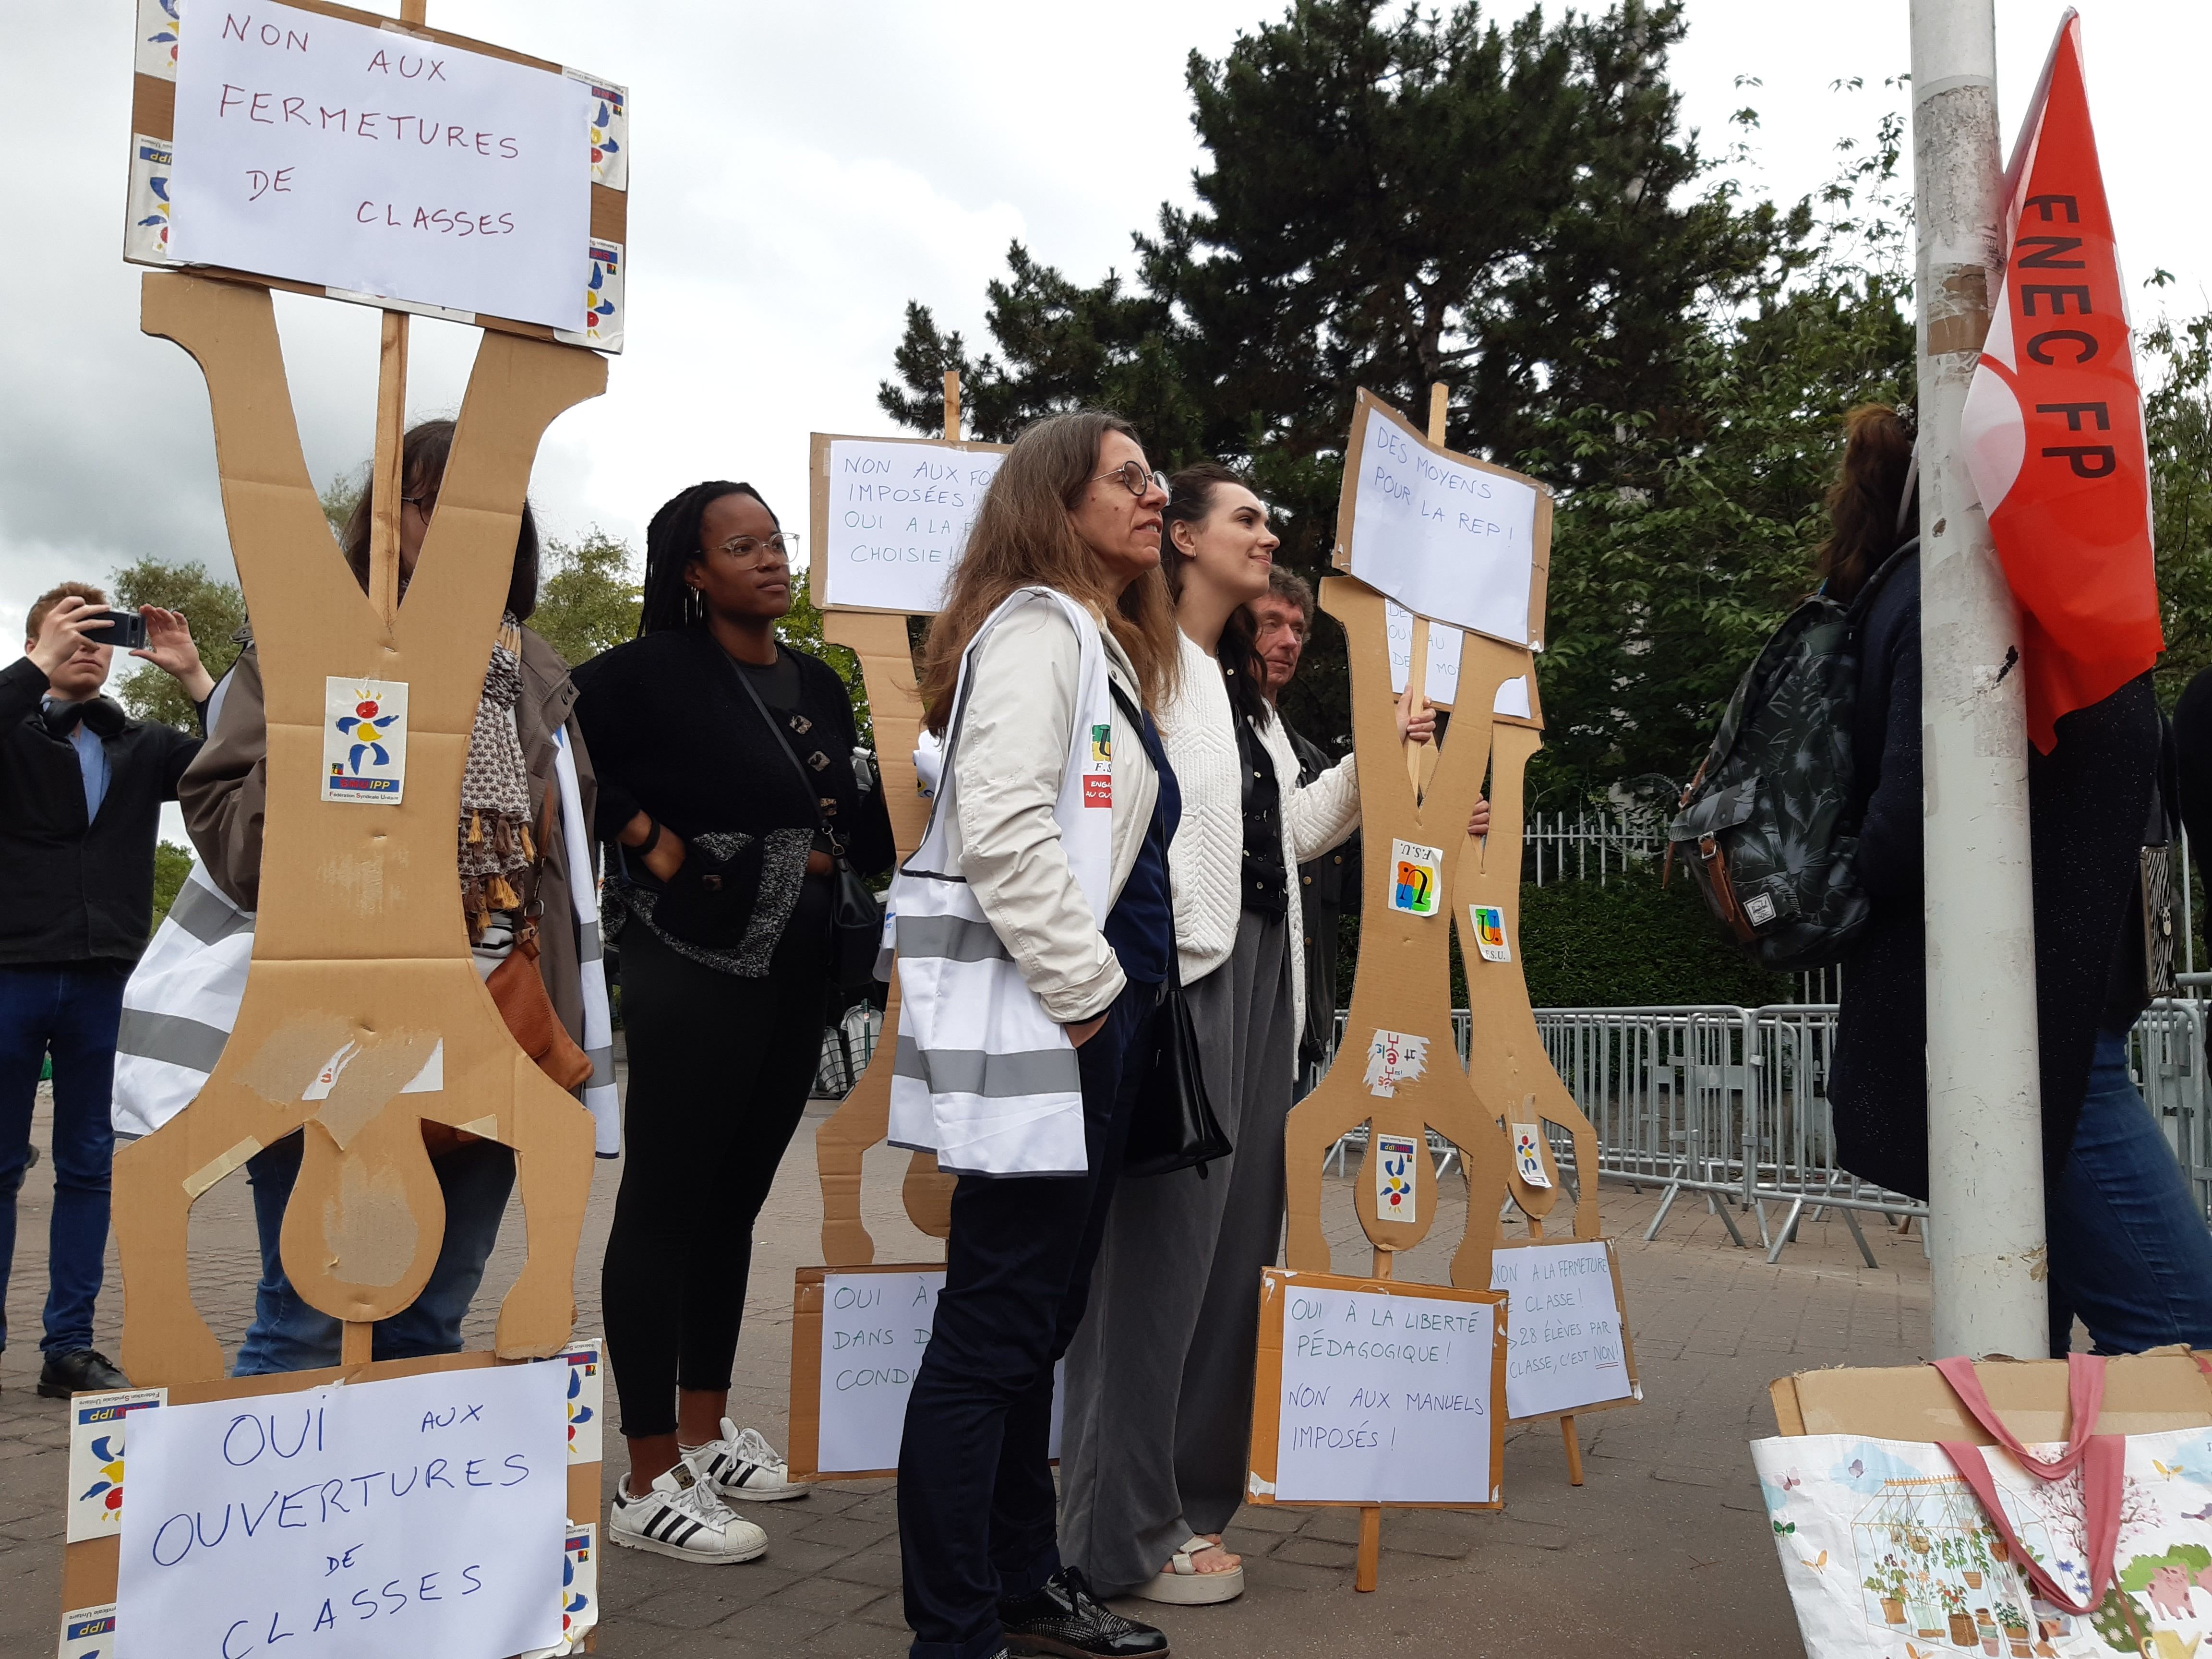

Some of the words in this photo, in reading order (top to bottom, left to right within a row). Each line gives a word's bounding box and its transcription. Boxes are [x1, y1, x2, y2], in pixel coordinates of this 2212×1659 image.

[222, 13, 308, 52] NON
[368, 49, 447, 81] AUX
[220, 84, 518, 159] FERMETURES
[246, 167, 296, 202] DE
[357, 201, 515, 236] CLASSES
[2035, 401, 2116, 479] FP
[845, 457, 890, 473] NON
[913, 461, 959, 483] AUX
[1377, 426, 1407, 464] DES
[1417, 457, 1491, 499] MOYENS
[1374, 467, 1410, 505] POUR
[1421, 500, 1445, 522] LA
[845, 511, 882, 529] OUI
[906, 517, 917, 533] A
[929, 519, 950, 534] LA
[1400, 843, 1431, 860] F.S.U.
[1485, 950, 1506, 960] F.S.U.
[1492, 1263, 1517, 1284] NON
[1533, 1264, 1539, 1281] A
[1544, 1263, 1555, 1279] LA
[1558, 1258, 1607, 1278] FERMETURE
[834, 1287, 880, 1310] OUI
[913, 1276, 927, 1307] À
[1291, 1298, 1322, 1321] OUI
[1345, 1300, 1357, 1322] À
[1372, 1308, 1394, 1327] LA
[1406, 1311, 1479, 1333] LIBERTÉ
[833, 1328, 894, 1349] DANS
[1519, 1328, 1537, 1346] 28
[1544, 1319, 1582, 1343] ÉLÈVES
[1589, 1321, 1611, 1335] PAR
[1510, 1356, 1557, 1379] CLASSE,
[1560, 1350, 1588, 1366] C'EST
[1288, 1383, 1331, 1407] NON
[1349, 1388, 1391, 1408] AUX
[1406, 1393, 1484, 1415] MANUELS
[422, 1404, 484, 1433] AUX
[1293, 1420, 1378, 1451] IMPOSÉS
[153, 1454, 530, 1566] OUVERTURES
[325, 1543, 364, 1576] DE
[222, 1565, 482, 1659] CLASSES
